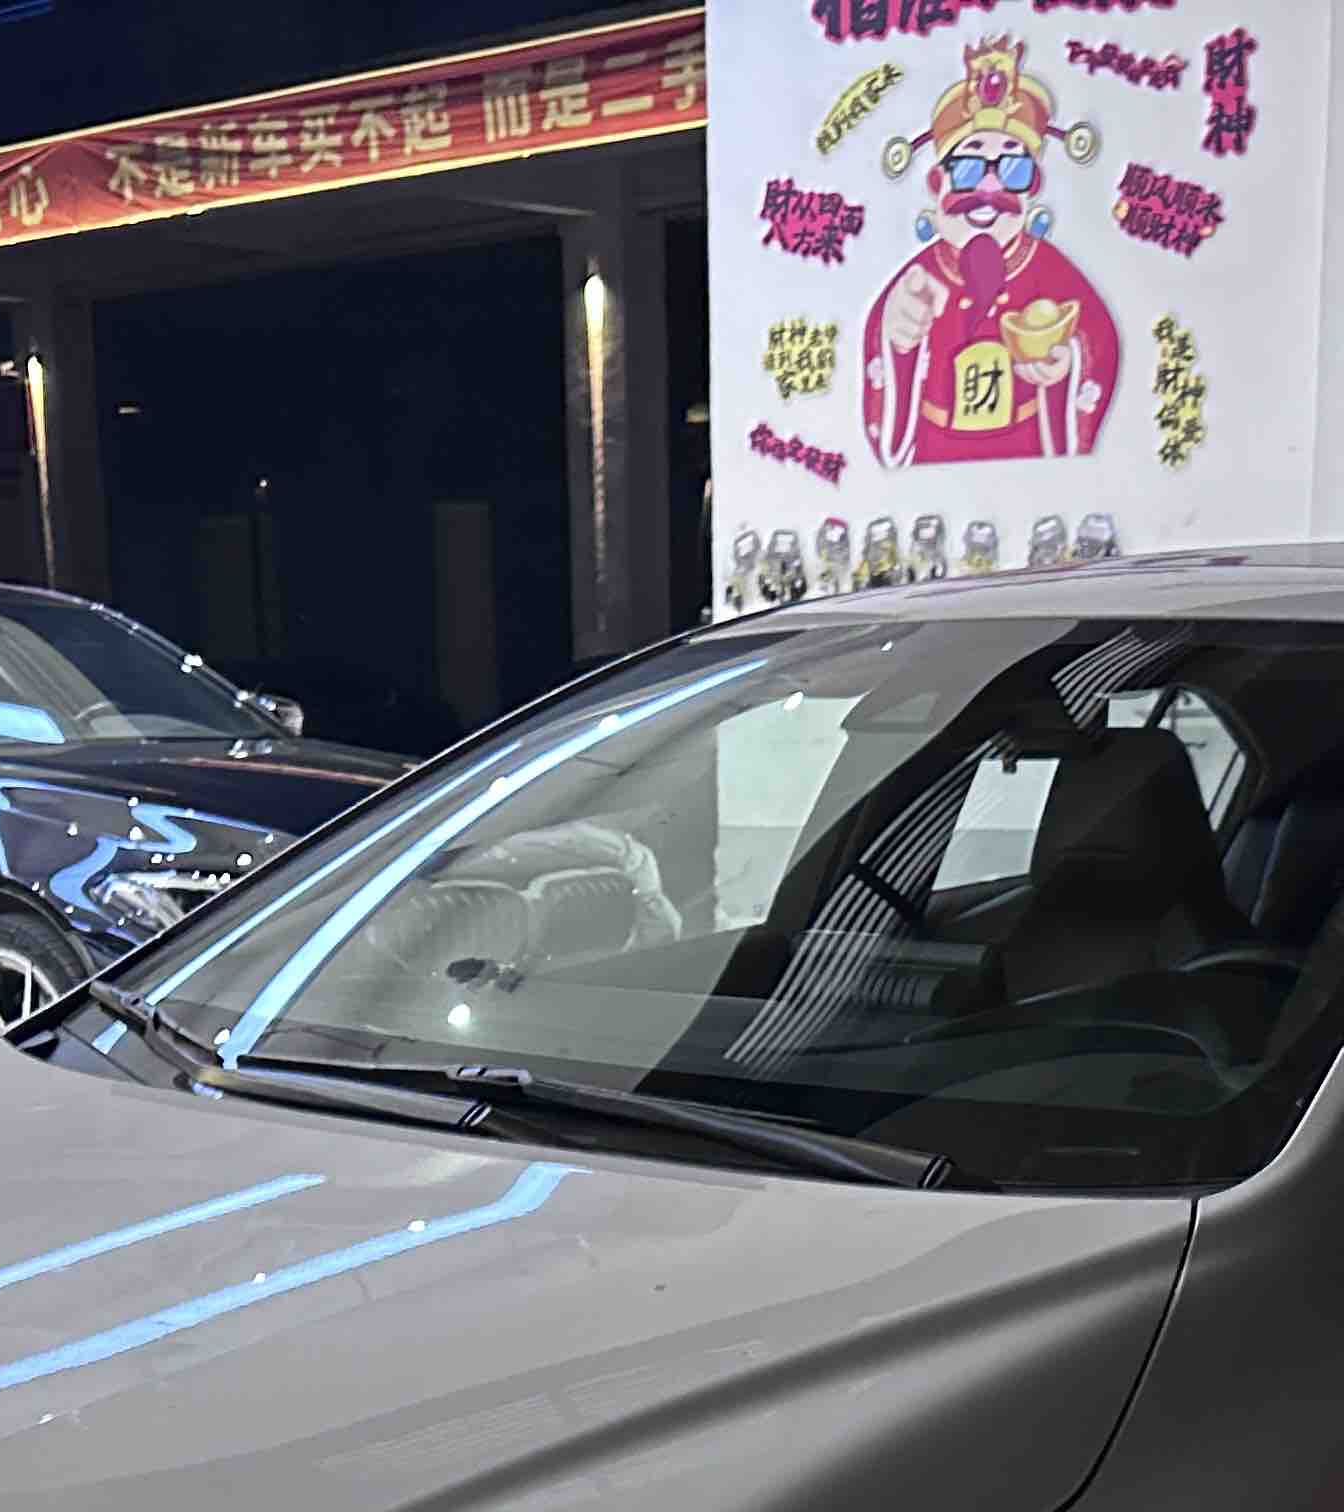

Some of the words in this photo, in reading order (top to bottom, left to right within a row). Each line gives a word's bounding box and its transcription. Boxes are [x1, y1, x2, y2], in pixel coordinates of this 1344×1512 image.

[105, 84, 454, 206] 不是新车买不起
